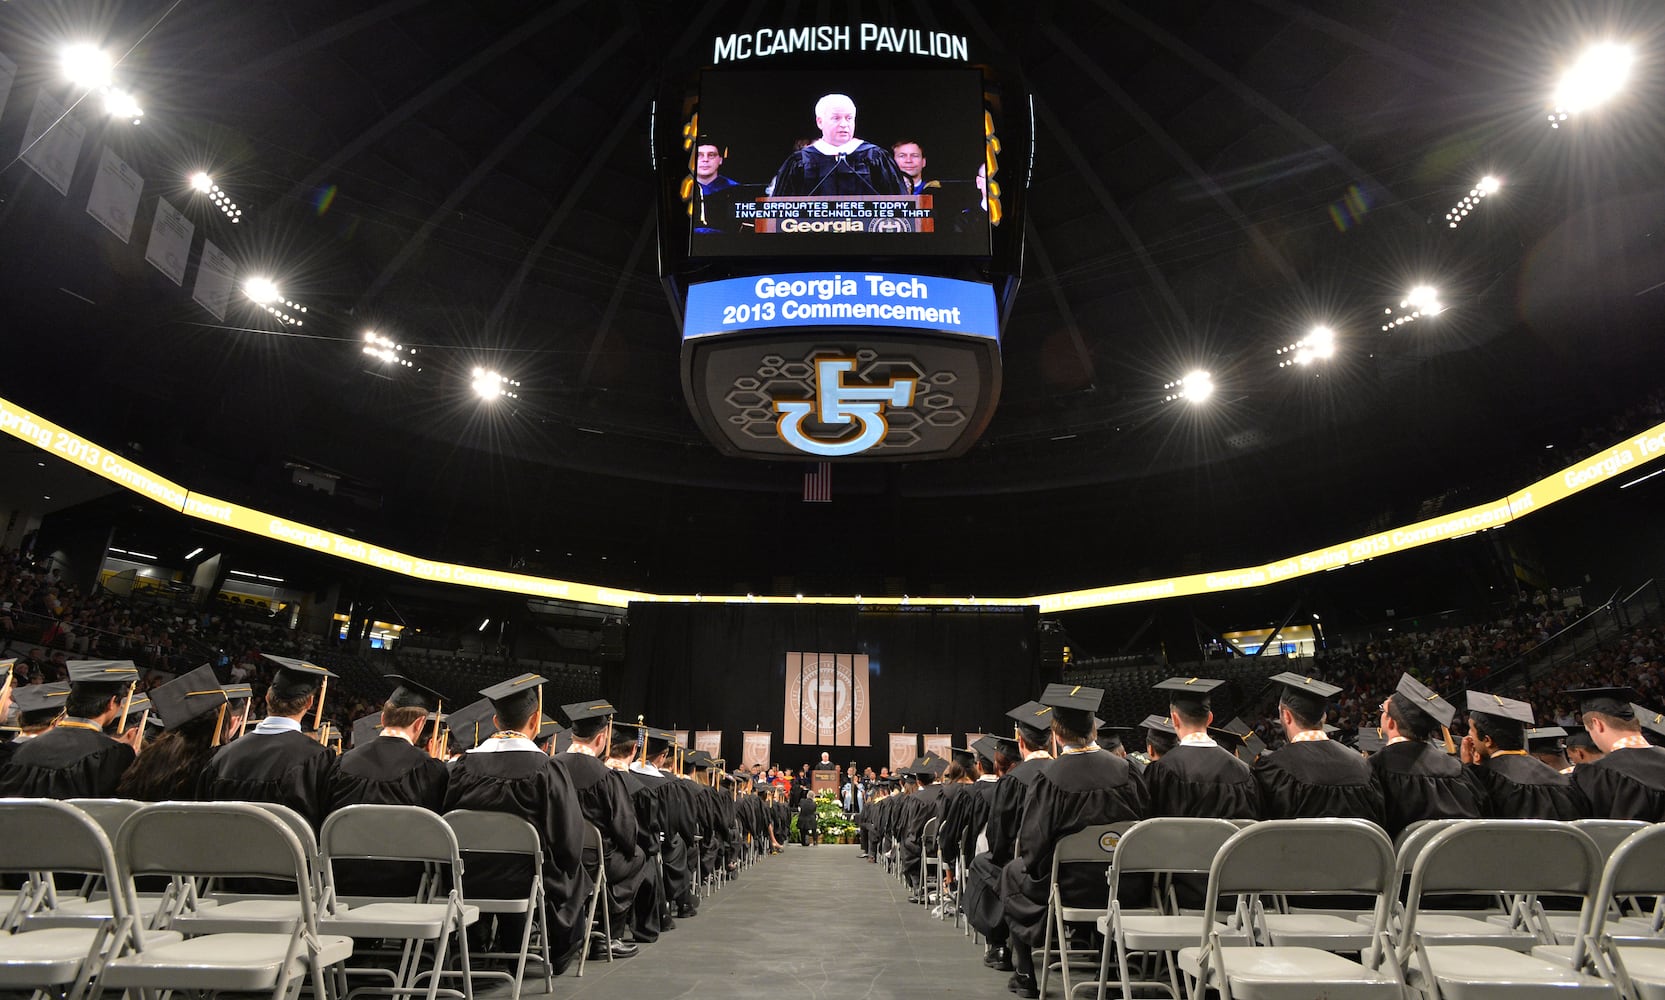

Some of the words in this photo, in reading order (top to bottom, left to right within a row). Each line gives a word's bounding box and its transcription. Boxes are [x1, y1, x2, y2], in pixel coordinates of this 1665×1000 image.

[860, 23, 969, 61] PAVILION
[734, 202, 757, 211] THE
[763, 202, 829, 211] GRADUATES
[835, 202, 867, 211] HERE
[872, 201, 909, 211] TODAY
[735, 210, 800, 219] INVENTING
[806, 210, 895, 219] TECHNOLOGIES
[901, 209, 931, 219] THAT
[780, 217, 865, 233] Georgia
[754, 275, 857, 299] Georgia
[865, 276, 928, 299] Tech
[722, 303, 777, 325] 2013
[781, 301, 961, 325] Commencement
[53, 433, 100, 466] 2013
[101, 455, 233, 521] Commencement
[1563, 448, 1635, 490] Georgia
[269, 519, 330, 551] Georgia
[332, 534, 367, 560] Tech
[368, 547, 414, 576] Spring
[414, 560, 452, 578] 2013
[1206, 571, 1266, 594] Georgia
[1267, 560, 1300, 580] Tech
[1300, 550, 1349, 577] Spring
[1349, 533, 1391, 559] 2013
[1392, 493, 1534, 545] Commencement
